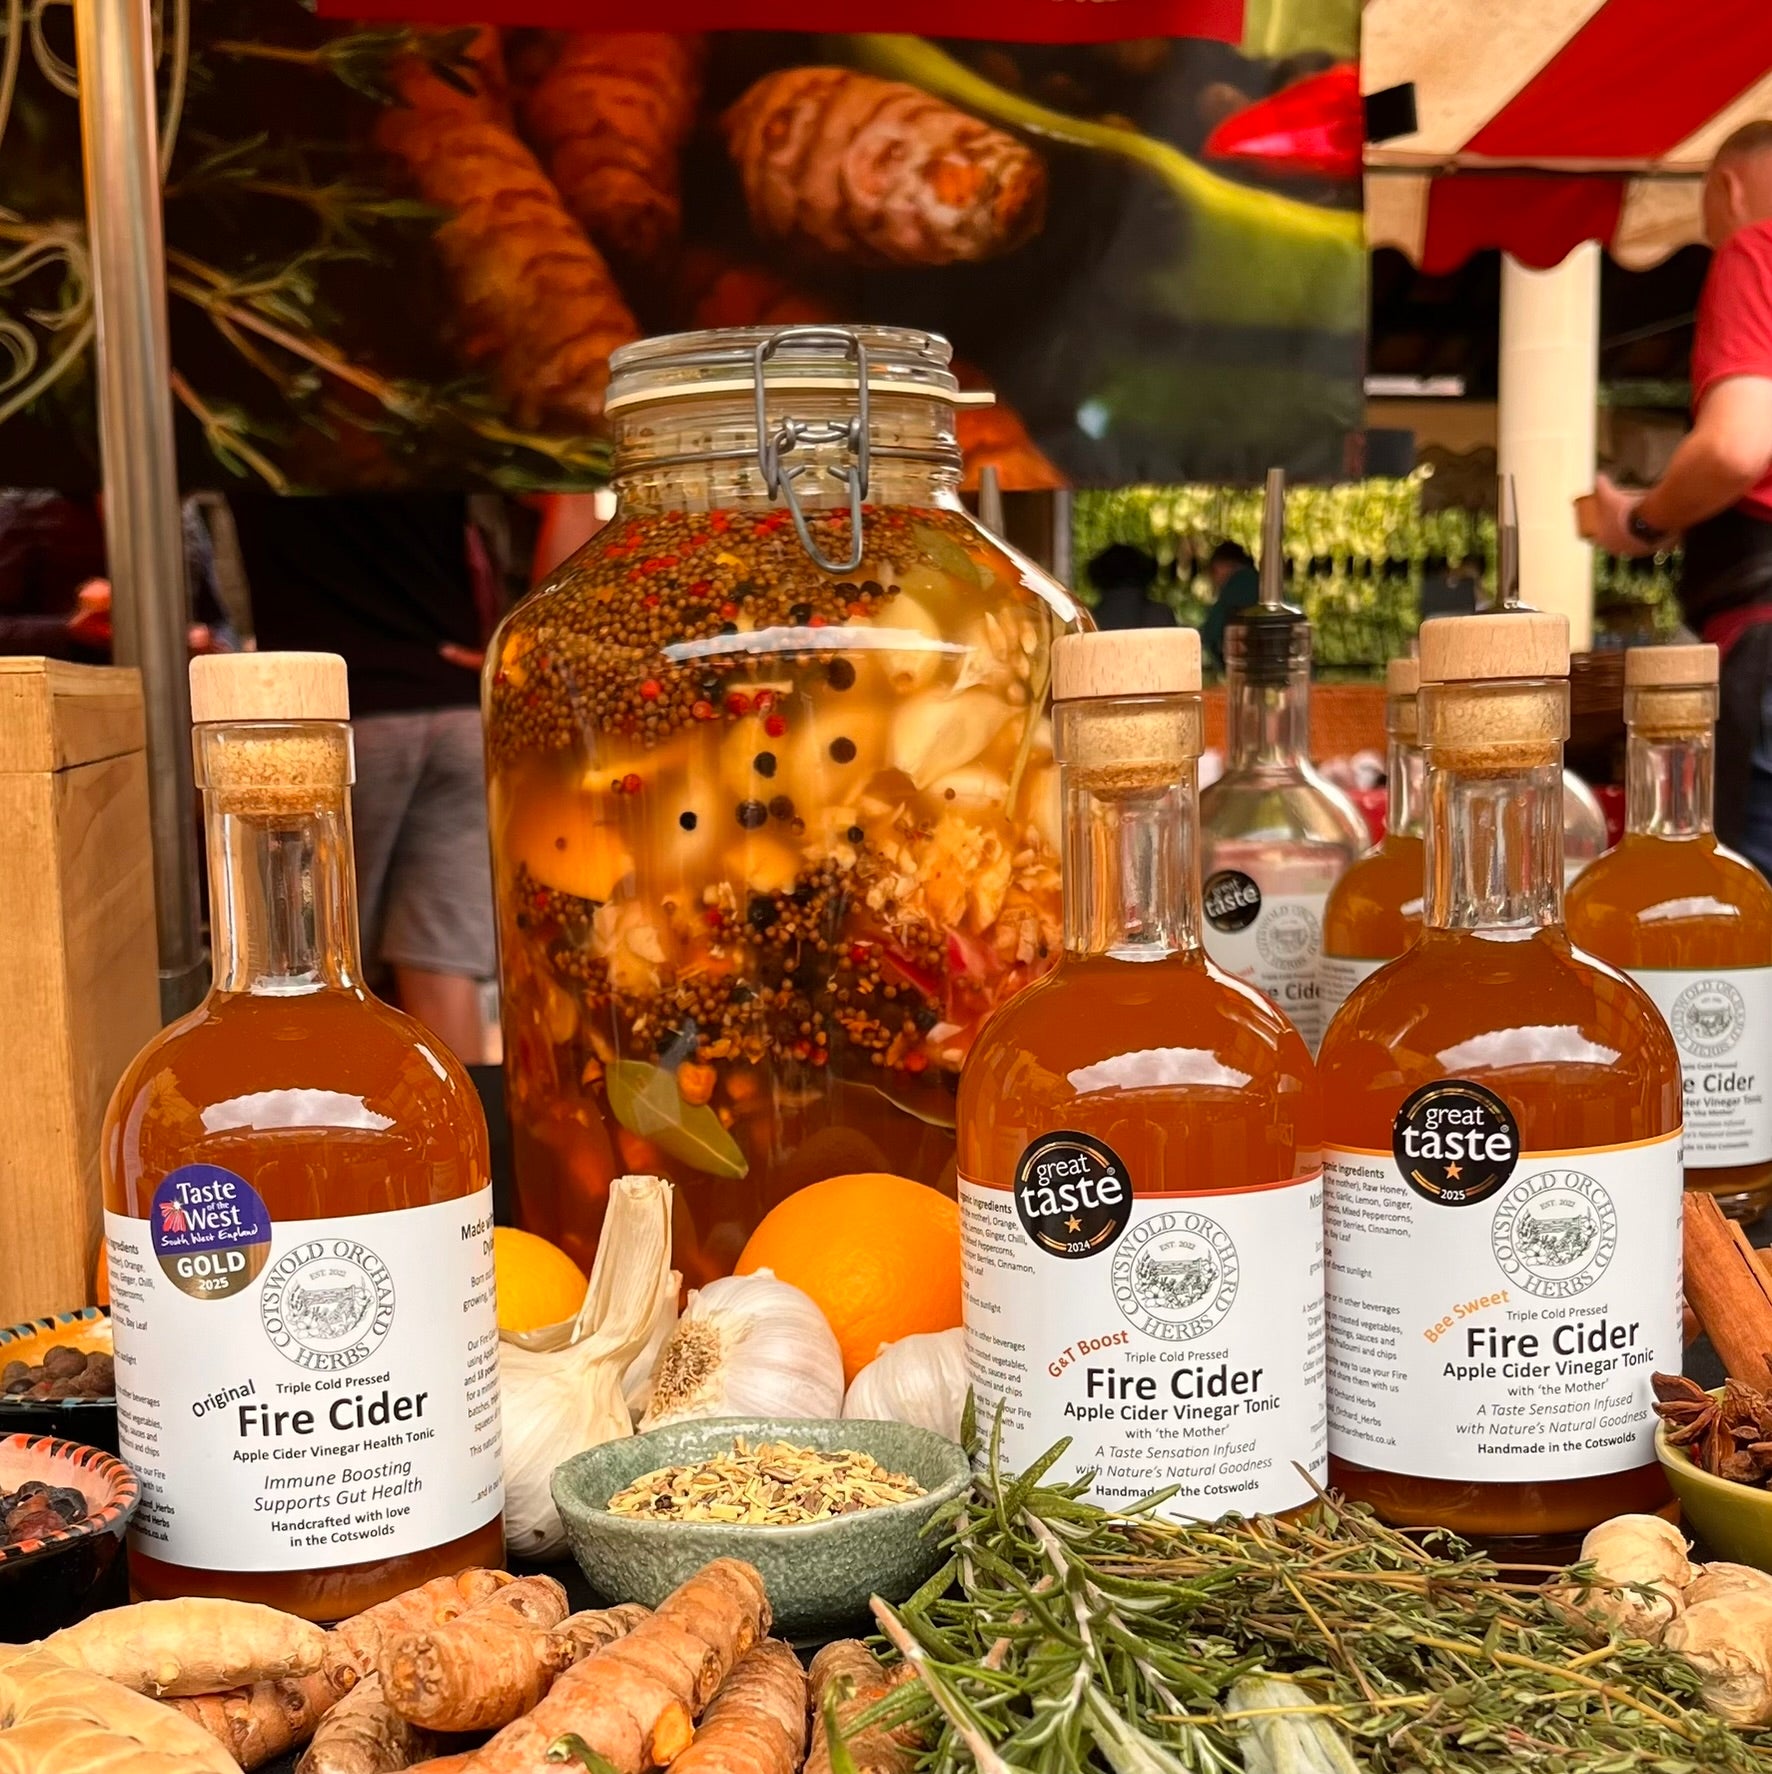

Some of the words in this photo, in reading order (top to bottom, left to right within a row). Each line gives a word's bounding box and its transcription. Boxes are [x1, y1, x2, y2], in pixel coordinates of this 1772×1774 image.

[1205, 884, 1259, 918] taste
[1704, 1072, 1754, 1093] Cider
[1425, 1106, 1484, 1130] great
[1402, 1125, 1511, 1161] taste
[1037, 1154, 1091, 1186] great
[176, 1180, 236, 1204] Taste
[1021, 1176, 1123, 1217] taste
[1363, 1183, 1377, 1191] Raw
[1380, 1186, 1408, 1196] Honey,
[1441, 1189, 1465, 1200] 2025
[207, 1202, 215, 1211] of
[1355, 1195, 1381, 1207] Lemon,
[1383, 1199, 1412, 1210] Ginger,
[184, 1206, 242, 1231] West
[992, 1217, 1018, 1230] Orange,
[1362, 1210, 1413, 1224] Peppercorns,
[1494, 1173, 1556, 1274] COTSWOLD
[1565, 1173, 1615, 1268] ORCHARD
[161, 1234, 189, 1246] South
[192, 1233, 215, 1244] West
[218, 1224, 258, 1240] England
[461, 1219, 485, 1241] Made
[1368, 1224, 1411, 1237] Cinnamon,
[1067, 1240, 1091, 1252] 2024
[177, 1252, 245, 1278] GOLD
[997, 1259, 1036, 1274] Cinnamon,
[1114, 1215, 1176, 1315] COTSWOLD
[1185, 1215, 1236, 1312] ORCHARD
[199, 1277, 229, 1290] 2025
[263, 1243, 324, 1347] COTSWOLD
[334, 1241, 393, 1336] ORCHARD
[1523, 1270, 1593, 1297] HERBS
[1362, 1301, 1400, 1315] beverages
[1423, 1314, 1455, 1343] Bee
[1453, 1289, 1511, 1319] Sweet
[1506, 1311, 1538, 1322] Triple
[1541, 1309, 1565, 1320] Cold
[1569, 1304, 1608, 1318] Pressed
[1141, 1314, 1213, 1339] HERBS
[1361, 1321, 1403, 1334] vegetables,
[1380, 1337, 1395, 1346] and
[1467, 1327, 1538, 1358] Fire
[1553, 1319, 1639, 1355] Cider
[295, 1342, 370, 1369] HERBS
[1048, 1347, 1077, 1378] G&T
[1077, 1330, 1129, 1356] Boost
[1125, 1352, 1156, 1364] Triple
[1159, 1351, 1185, 1362] Cold
[1188, 1349, 1228, 1361] Pressed
[1362, 1347, 1375, 1356] and
[1377, 1350, 1397, 1361] chips
[1443, 1362, 1496, 1381] Apple
[1502, 1363, 1550, 1378] Cider
[1555, 1358, 1619, 1376] Vinegar
[1622, 1347, 1654, 1368] Tonic
[276, 1383, 311, 1395] Triple
[315, 1379, 342, 1392] Cold
[346, 1372, 391, 1387] Pressed
[1008, 1373, 1021, 1383] and
[1087, 1368, 1157, 1400] Fire
[1170, 1364, 1263, 1399] Cider
[1359, 1366, 1371, 1374] use
[1372, 1368, 1390, 1378] your
[1392, 1370, 1408, 1380] Fire
[1005, 1386, 1023, 1397] chips
[1371, 1380, 1387, 1391] with
[1390, 1385, 1399, 1393] us
[1508, 1385, 1534, 1396] with
[192, 1379, 256, 1418] Original
[1064, 1402, 1115, 1422] Apple
[1120, 1405, 1169, 1420] Cider
[1174, 1403, 1240, 1421] Vinegar
[1244, 1395, 1280, 1414] Tonic
[1356, 1397, 1376, 1408] Herbs
[1477, 1405, 1486, 1415] A
[1491, 1404, 1525, 1416] Taste
[1529, 1401, 1590, 1416] Sensation
[1594, 1393, 1633, 1411] Infused
[239, 1403, 314, 1436] Fire
[329, 1391, 428, 1430] Cider
[1018, 1407, 1032, 1418] Fire
[1456, 1423, 1484, 1435] with
[1549, 1418, 1596, 1433] Natural
[1599, 1409, 1647, 1427] Goodness
[1016, 1422, 1024, 1430] us
[1126, 1427, 1152, 1439] with
[233, 1450, 269, 1463] Apple
[273, 1447, 307, 1459] Cider
[310, 1442, 360, 1457] Vinegar
[363, 1435, 404, 1450] Health
[406, 1428, 435, 1443] Tonic
[1095, 1446, 1104, 1457] A
[1109, 1446, 1143, 1459] Taste
[1147, 1445, 1210, 1459] Sensation
[1213, 1439, 1256, 1457] Infused
[1478, 1444, 1545, 1454] Handmade
[1549, 1443, 1560, 1452] in
[1563, 1442, 1582, 1451] the
[1585, 1432, 1636, 1449] Cotswolds
[154, 1468, 166, 1480] Fire
[264, 1473, 336, 1490] Immune
[341, 1460, 412, 1483] Boosting
[1076, 1464, 1102, 1476] with
[1166, 1463, 1215, 1478] Natural
[1218, 1456, 1272, 1474] Goodness
[156, 1485, 163, 1493] us
[253, 1493, 330, 1514] Supports
[336, 1488, 367, 1504] Gut
[372, 1477, 423, 1500] Health
[1096, 1485, 1158, 1497] Handmad
[1181, 1484, 1200, 1496] the
[1204, 1480, 1259, 1495] Cotswolds
[271, 1515, 350, 1532] Handcrafted
[355, 1509, 383, 1525] with
[386, 1504, 410, 1519] love
[290, 1535, 302, 1547] in
[306, 1531, 327, 1546] the
[330, 1523, 395, 1544] Cotswolds
